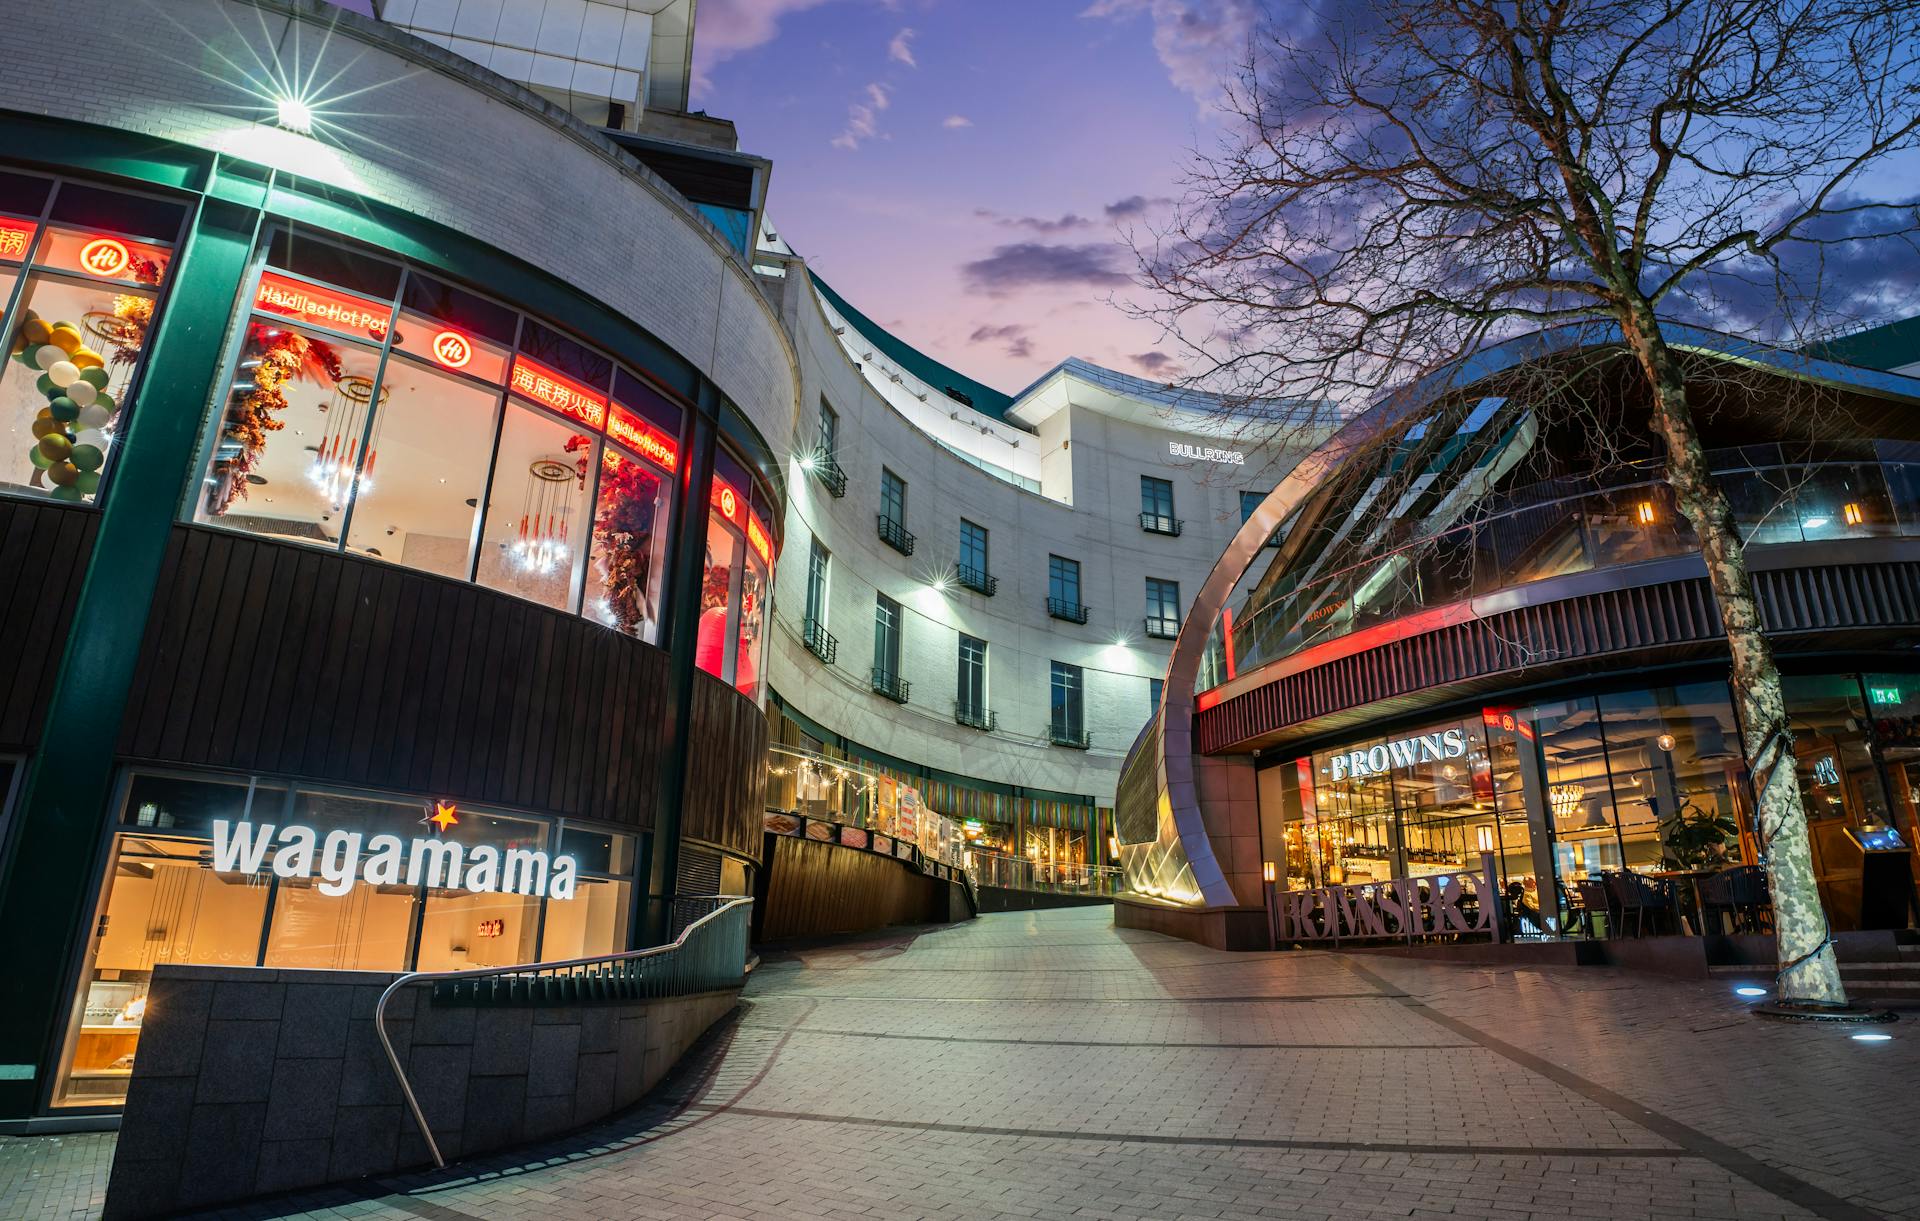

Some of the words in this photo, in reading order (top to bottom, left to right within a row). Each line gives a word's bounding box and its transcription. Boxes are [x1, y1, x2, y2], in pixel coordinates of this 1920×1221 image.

[360, 314, 389, 334] Pot
[512, 366, 604, 425] 海底捞火锅
[1169, 442, 1244, 465] BULLRING
[1330, 728, 1465, 782] BROWNS
[213, 819, 577, 900] wagamama
